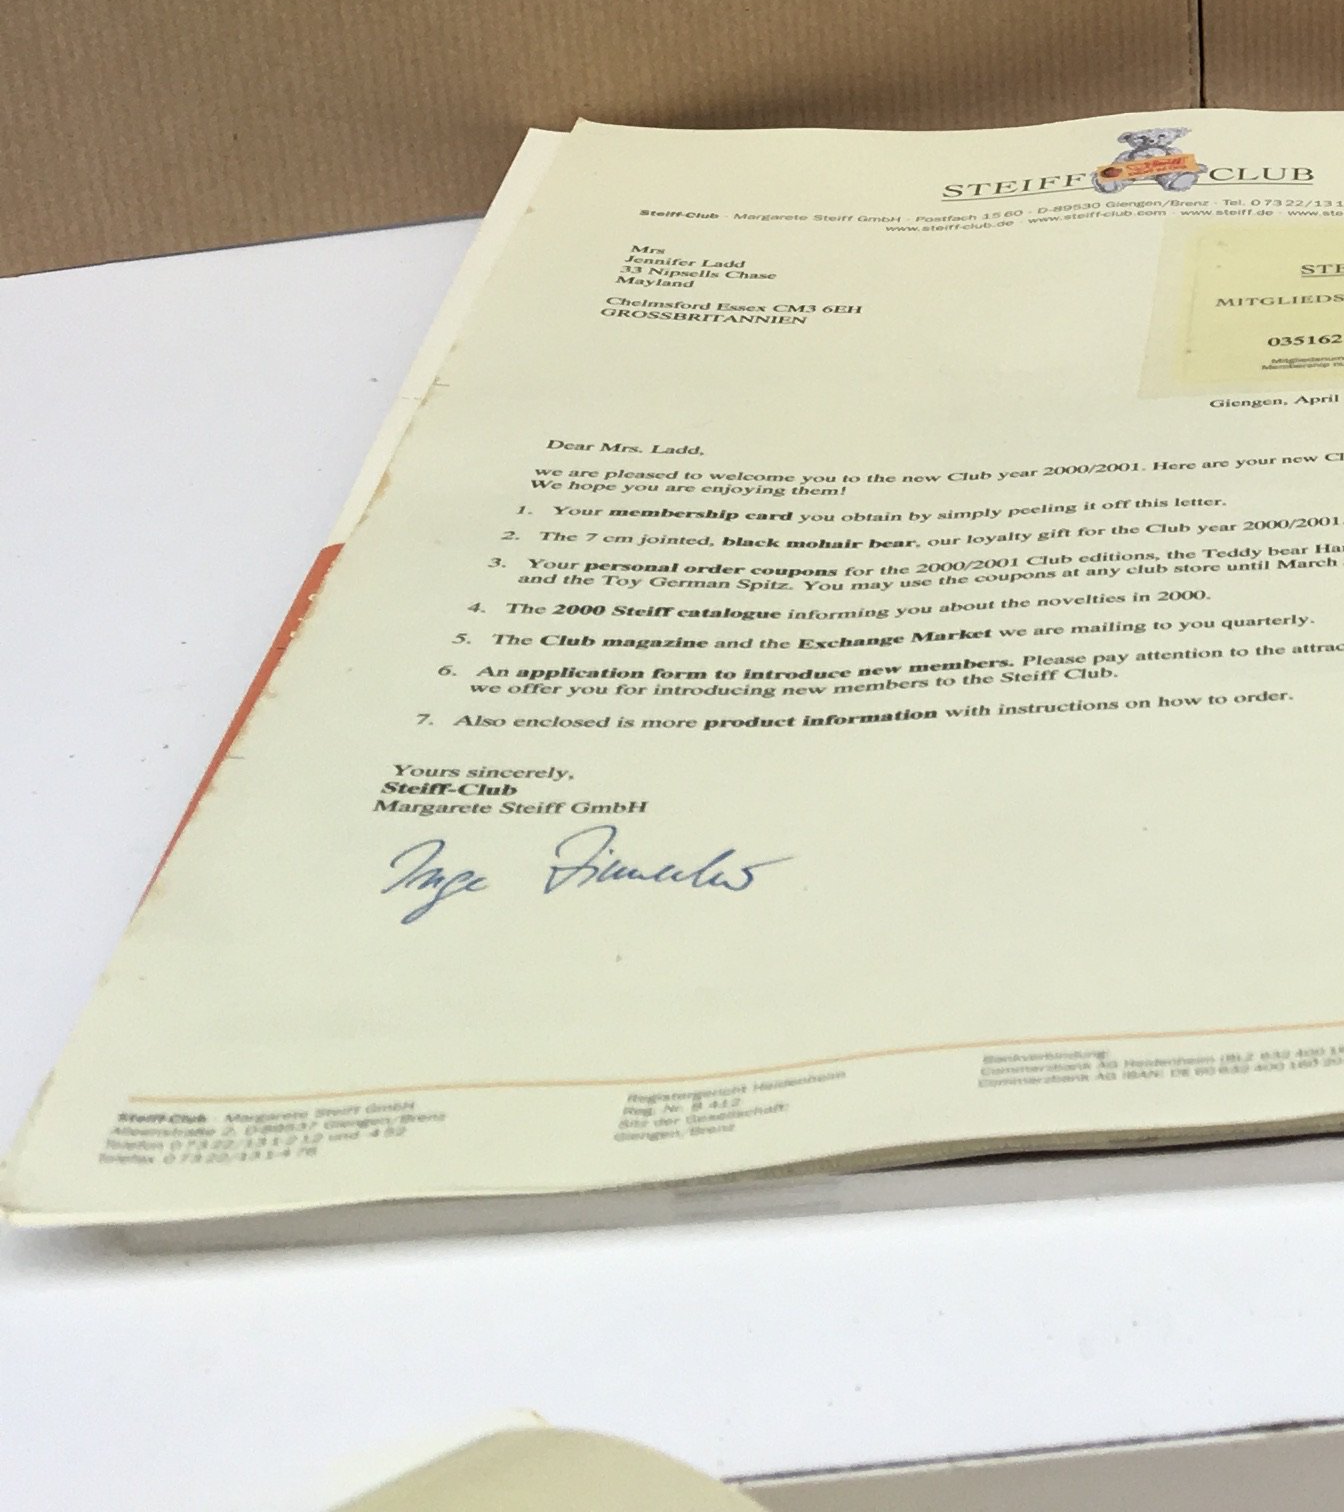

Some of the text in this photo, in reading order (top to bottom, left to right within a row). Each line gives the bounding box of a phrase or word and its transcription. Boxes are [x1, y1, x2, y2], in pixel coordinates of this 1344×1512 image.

[941, 172, 1086, 198] STEIFF
[1208, 167, 1316, 183] CLUB
[629, 244, 665, 255] Mrs
[623, 254, 746, 268] Jennifer Ladd
[619, 264, 777, 280] 33 Nipsells Chase
[614, 275, 695, 288] Mayland
[604, 296, 862, 314] Chelmsford Essex CM3 6EH
[599, 307, 807, 324] GROSSBRITANNIEN
[1266, 333, 1342, 347] 035162
[1208, 398, 1288, 408] Giengen,
[1293, 393, 1339, 406] April
[534, 468, 563, 479] we
[567, 469, 599, 480] are
[603, 468, 679, 480] pleased
[683, 471, 703, 480] to
[708, 471, 795, 484] welcome
[799, 474, 836, 485] you
[841, 474, 861, 483] to
[866, 472, 896, 483] the
[901, 474, 941, 483] new
[946, 470, 992, 481] Club
[996, 469, 1038, 481] year
[1042, 461, 1145, 476] 2000/2001.
[1152, 460, 1196, 471] Here
[1201, 459, 1229, 469] are
[1234, 456, 1277, 469] your
[1281, 455, 1318, 464] new
[530, 479, 846, 497] We hope you are enjoying them!
[500, 530, 519, 540] 2.
[539, 530, 578, 542] The
[586, 532, 598, 541] 7
[602, 535, 633, 543] cm
[636, 533, 714, 547] jointed,
[721, 535, 779, 548] black
[785, 538, 863, 549] mohair
[926, 537, 961, 547] our
[966, 531, 1032, 546] loyalty
[1036, 527, 1070, 542] gift
[1077, 526, 1106, 537] for
[1110, 524, 1140, 535] the
[1144, 522, 1191, 533] Club
[1196, 523, 1237, 535] year
[467, 589, 1211, 621] 4. The 2000 Steiff catalogue informing you about the novelties in 2000.
[393, 763, 574, 782] Yours sincerely,
[380, 781, 518, 796] Steiff-Club
[372, 798, 648, 817] Margarete Steiff GmbH
